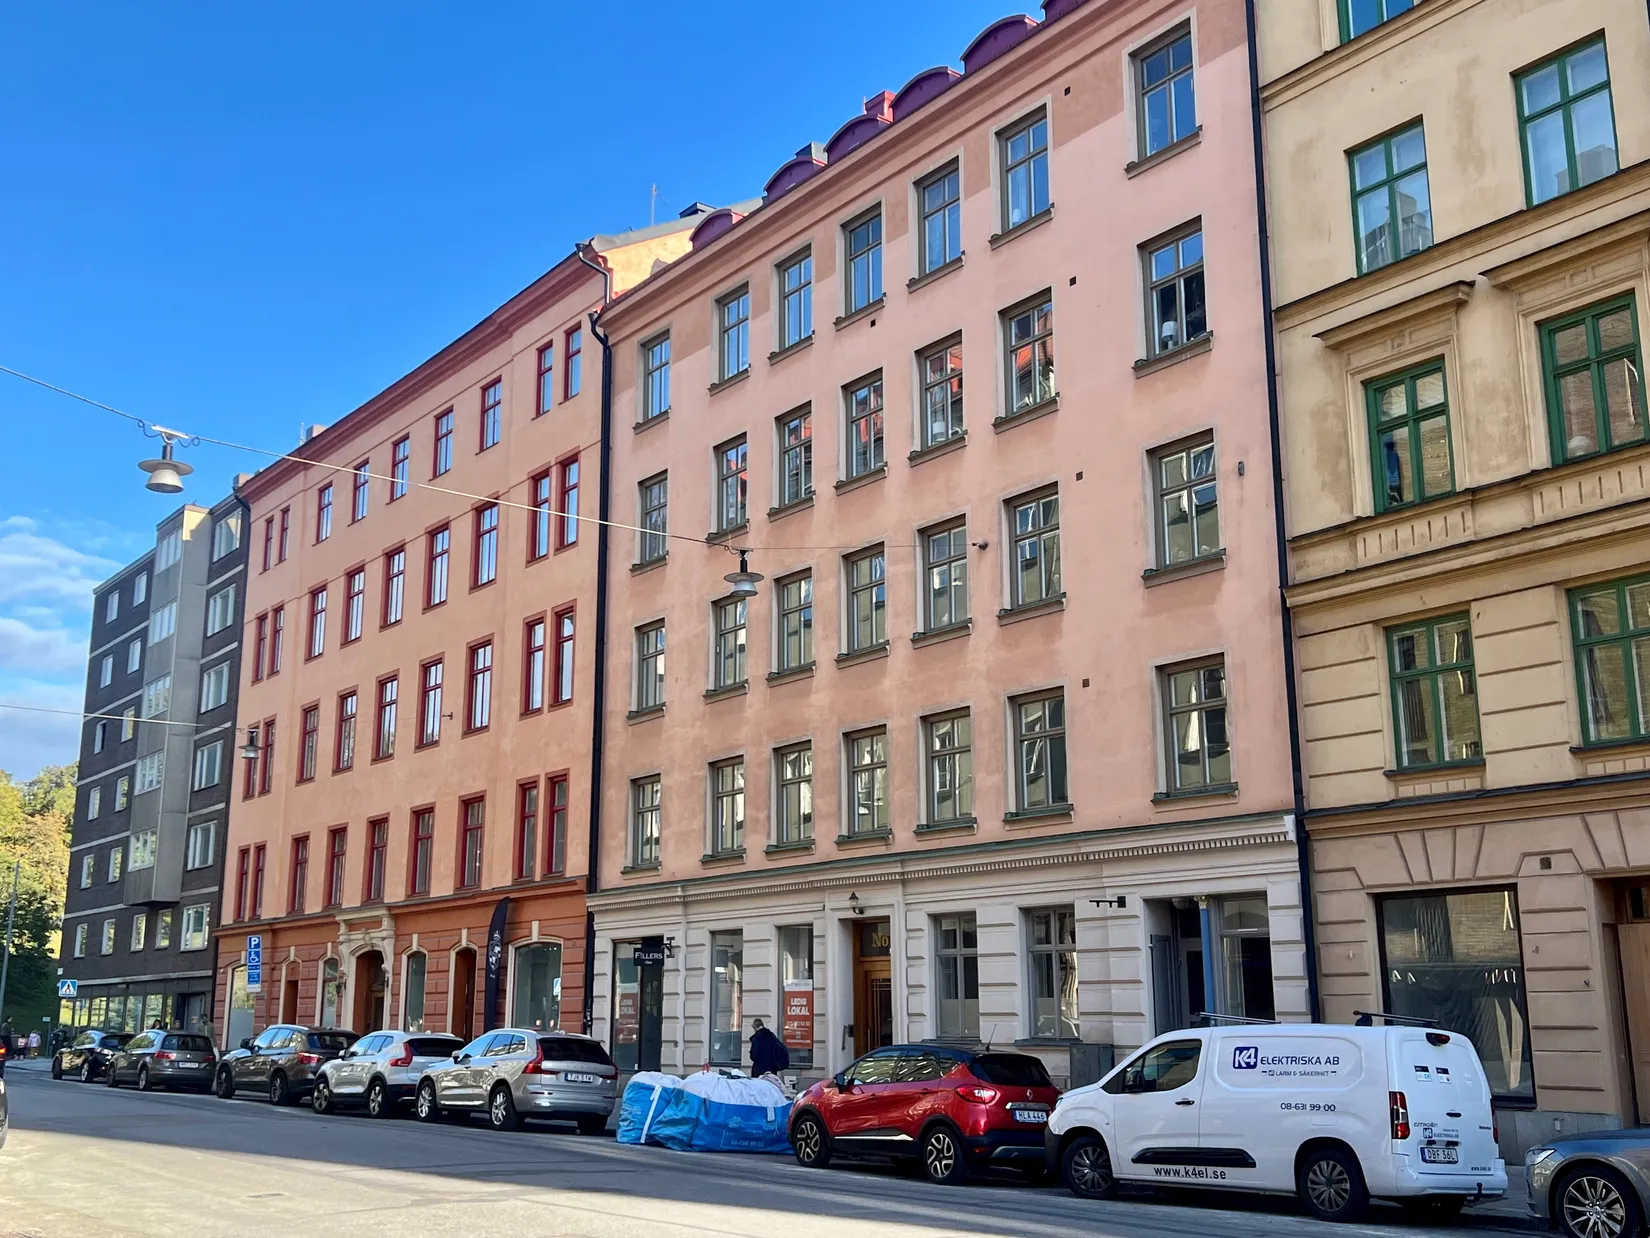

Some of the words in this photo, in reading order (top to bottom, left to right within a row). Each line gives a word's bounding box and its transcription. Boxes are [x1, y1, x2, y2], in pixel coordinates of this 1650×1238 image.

[251, 937, 259, 949] P
[790, 997, 807, 1006] LEDIG
[787, 1006, 810, 1016] LOKAL
[1234, 1047, 1257, 1069] K4
[1260, 1056, 1322, 1066] ELEKTRISKA
[1324, 1056, 1340, 1066] AB
[1280, 1102, 1307, 1111] 08-631
[1309, 1103, 1321, 1112] 99
[1323, 1103, 1336, 1112] 00
[1153, 1166, 1227, 1180] www.k4el.se
